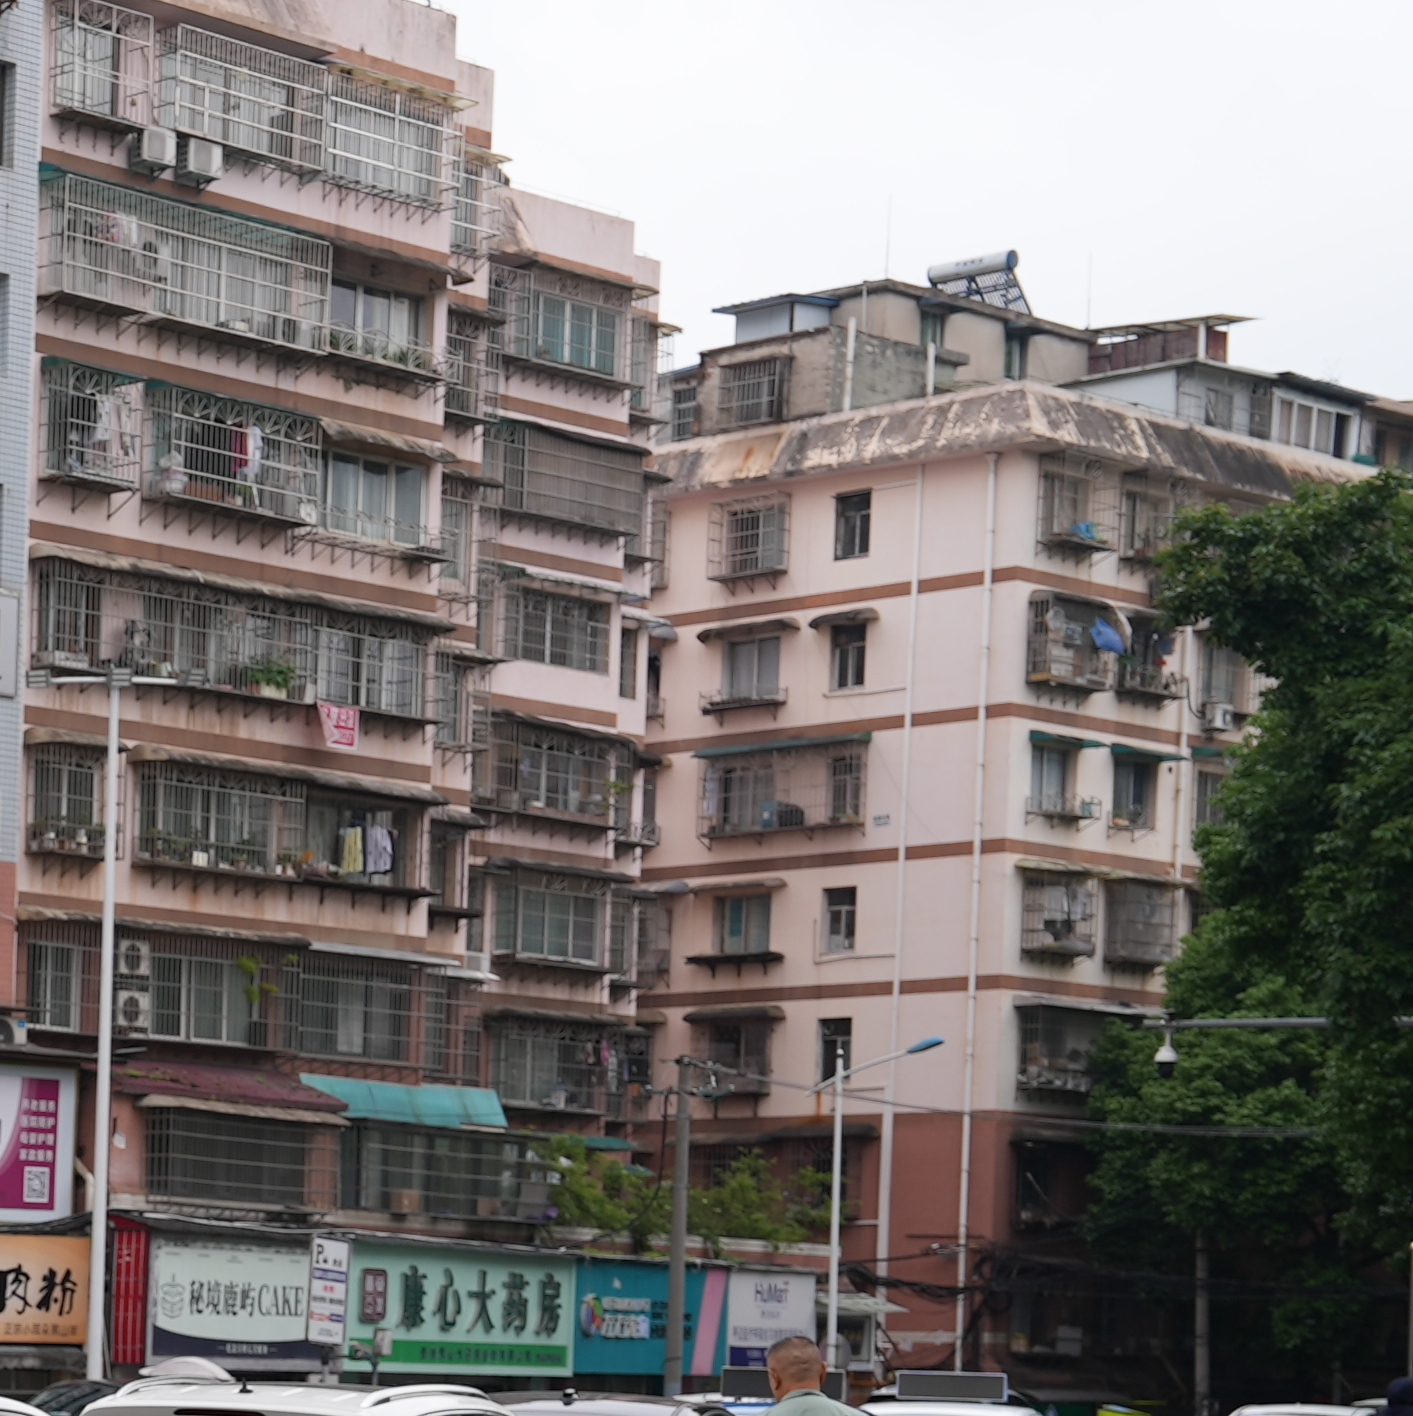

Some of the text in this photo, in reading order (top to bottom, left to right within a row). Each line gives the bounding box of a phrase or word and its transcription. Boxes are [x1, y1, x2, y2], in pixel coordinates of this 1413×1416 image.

[395, 1264, 562, 1338] 康心大药房
